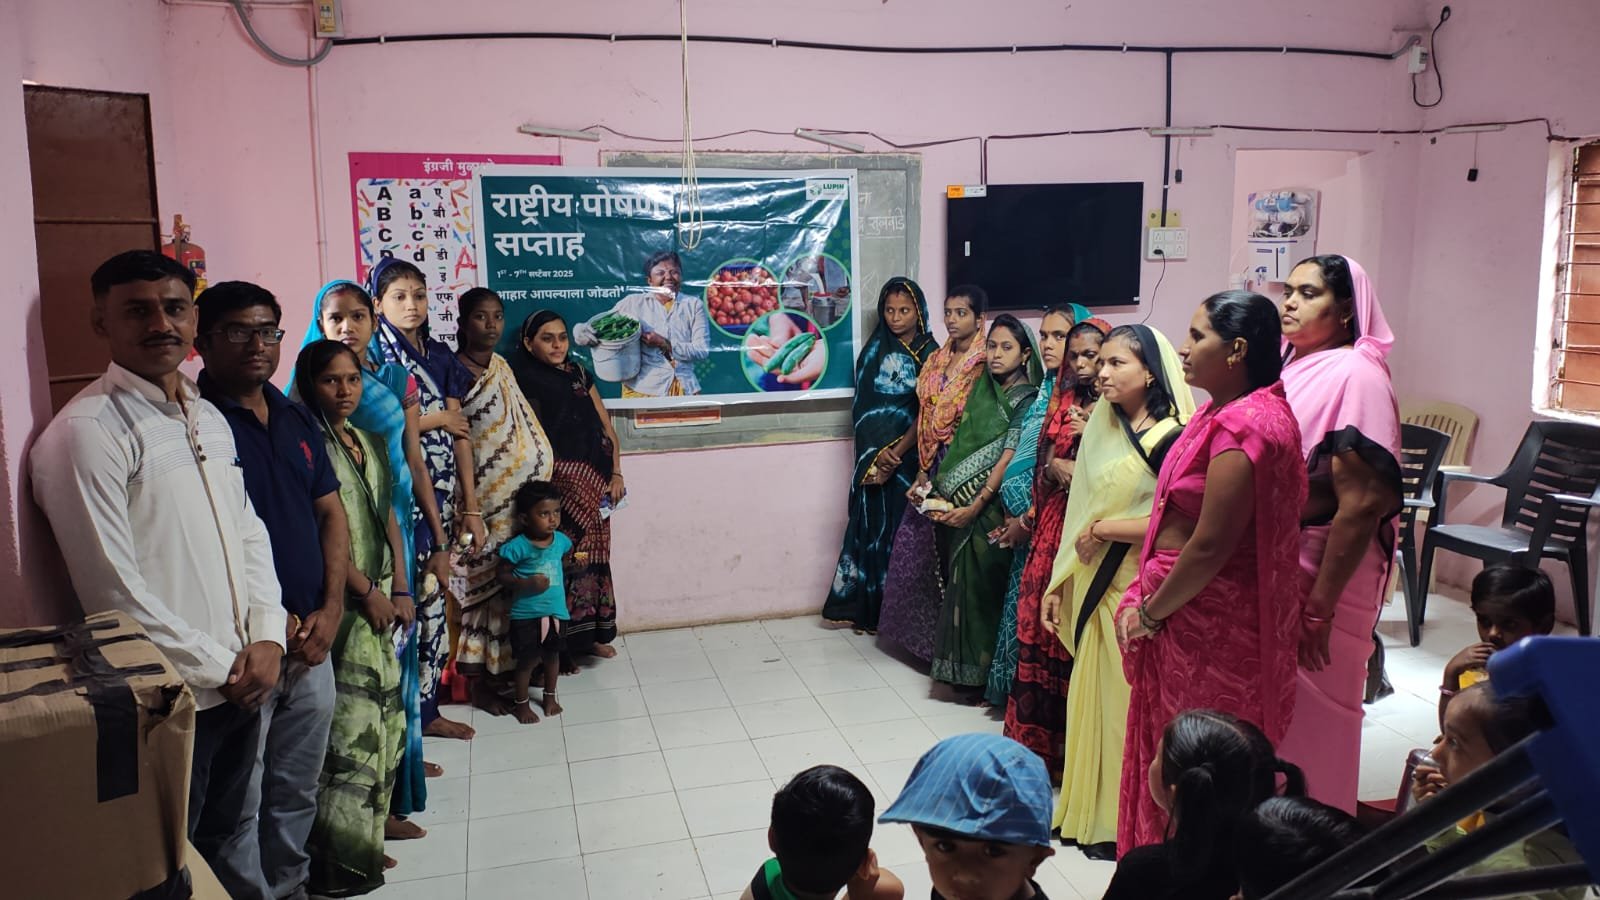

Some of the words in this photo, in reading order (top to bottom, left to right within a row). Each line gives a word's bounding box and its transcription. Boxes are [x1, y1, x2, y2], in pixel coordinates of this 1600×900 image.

[422, 157, 454, 174] इंग्रजी
[377, 186, 393, 201] A
[409, 188, 422, 199] a
[433, 187, 444, 200] ए
[377, 207, 392, 221] B
[410, 206, 423, 220] b
[432, 204, 446, 218] बी
[490, 184, 574, 226] राष्ट्रीय
[580, 185, 660, 217] पोषण
[378, 228, 393, 243] C
[412, 230, 424, 241] c
[433, 226, 448, 240] सी
[492, 232, 586, 261] सप्ताह
[413, 247, 425, 262] d
[435, 247, 448, 261] डी
[552, 270, 574, 278] 2025
[435, 292, 453, 304] एफ
[530, 288, 584, 300] आपल्याला
[437, 310, 453, 322] जी
[438, 333, 456, 342] एच
